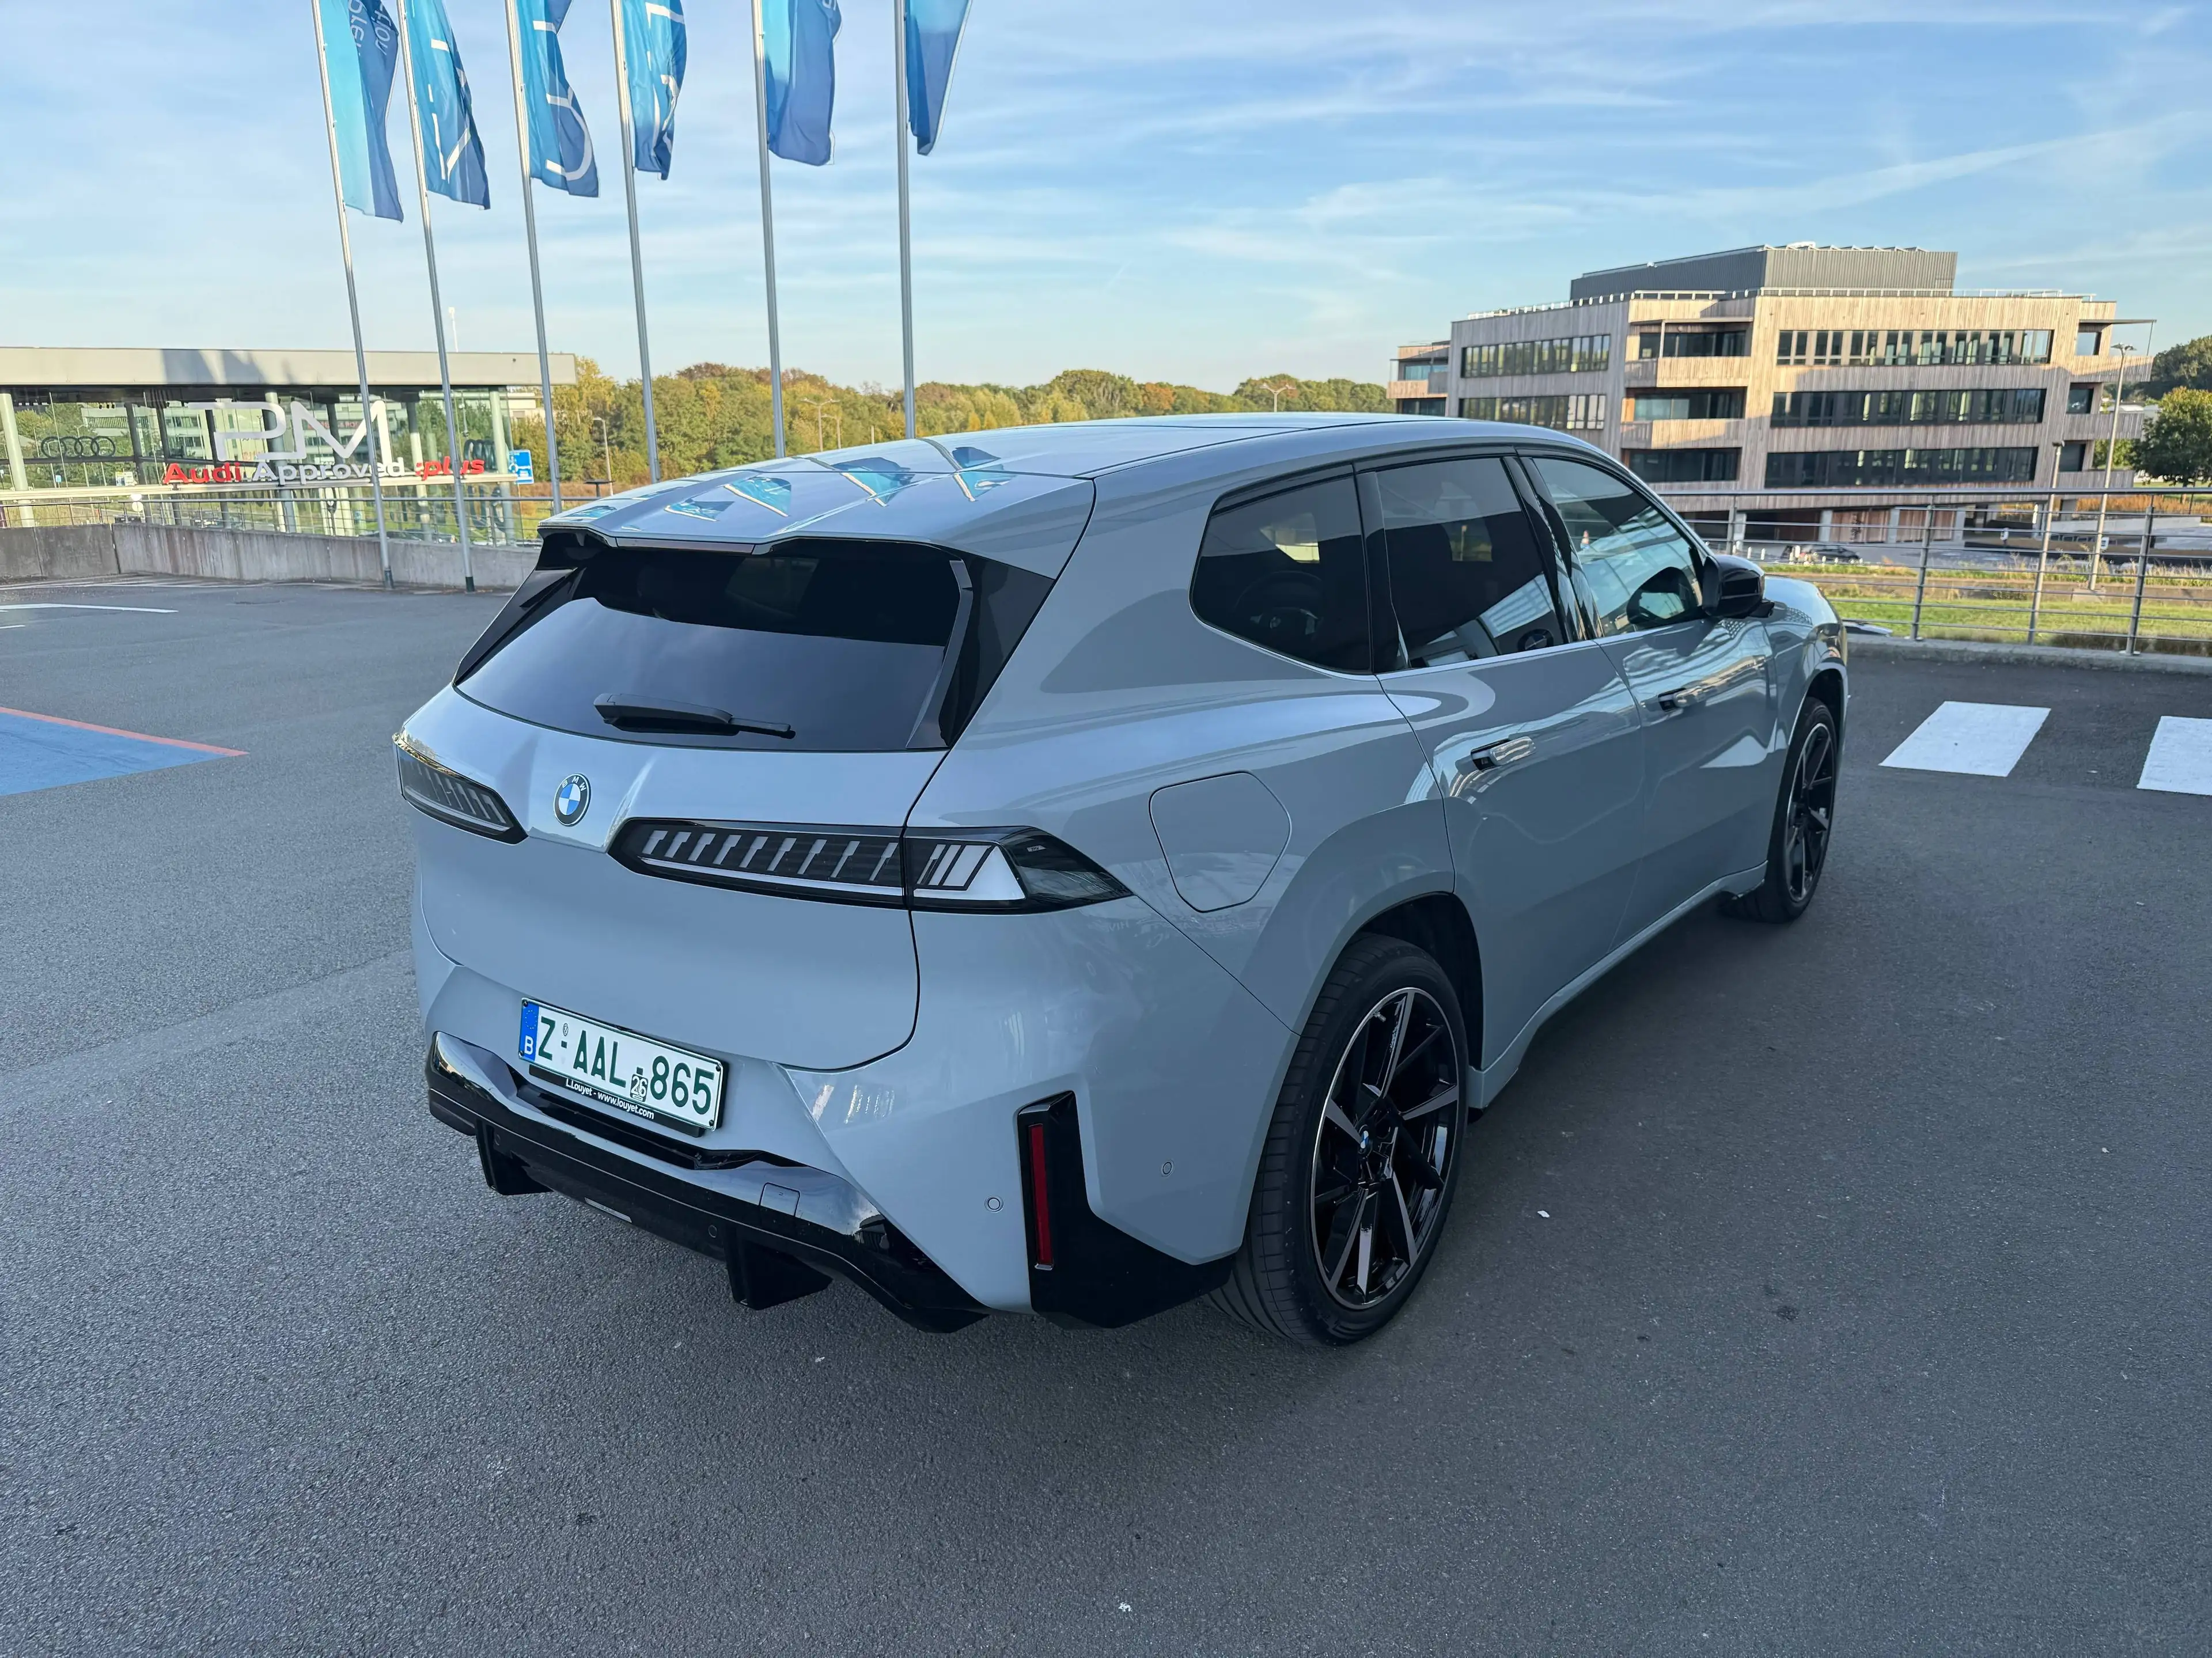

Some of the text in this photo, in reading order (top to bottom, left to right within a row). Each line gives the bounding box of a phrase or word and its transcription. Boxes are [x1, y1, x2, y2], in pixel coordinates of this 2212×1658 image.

[162, 462, 242, 484] Audi
[253, 457, 406, 485] Approved
[562, 776, 586, 791] BMW
[524, 1035, 534, 1055] B
[566, 1077, 593, 1095] L.Louyet
[597, 1091, 654, 1120] www.louyet.com
